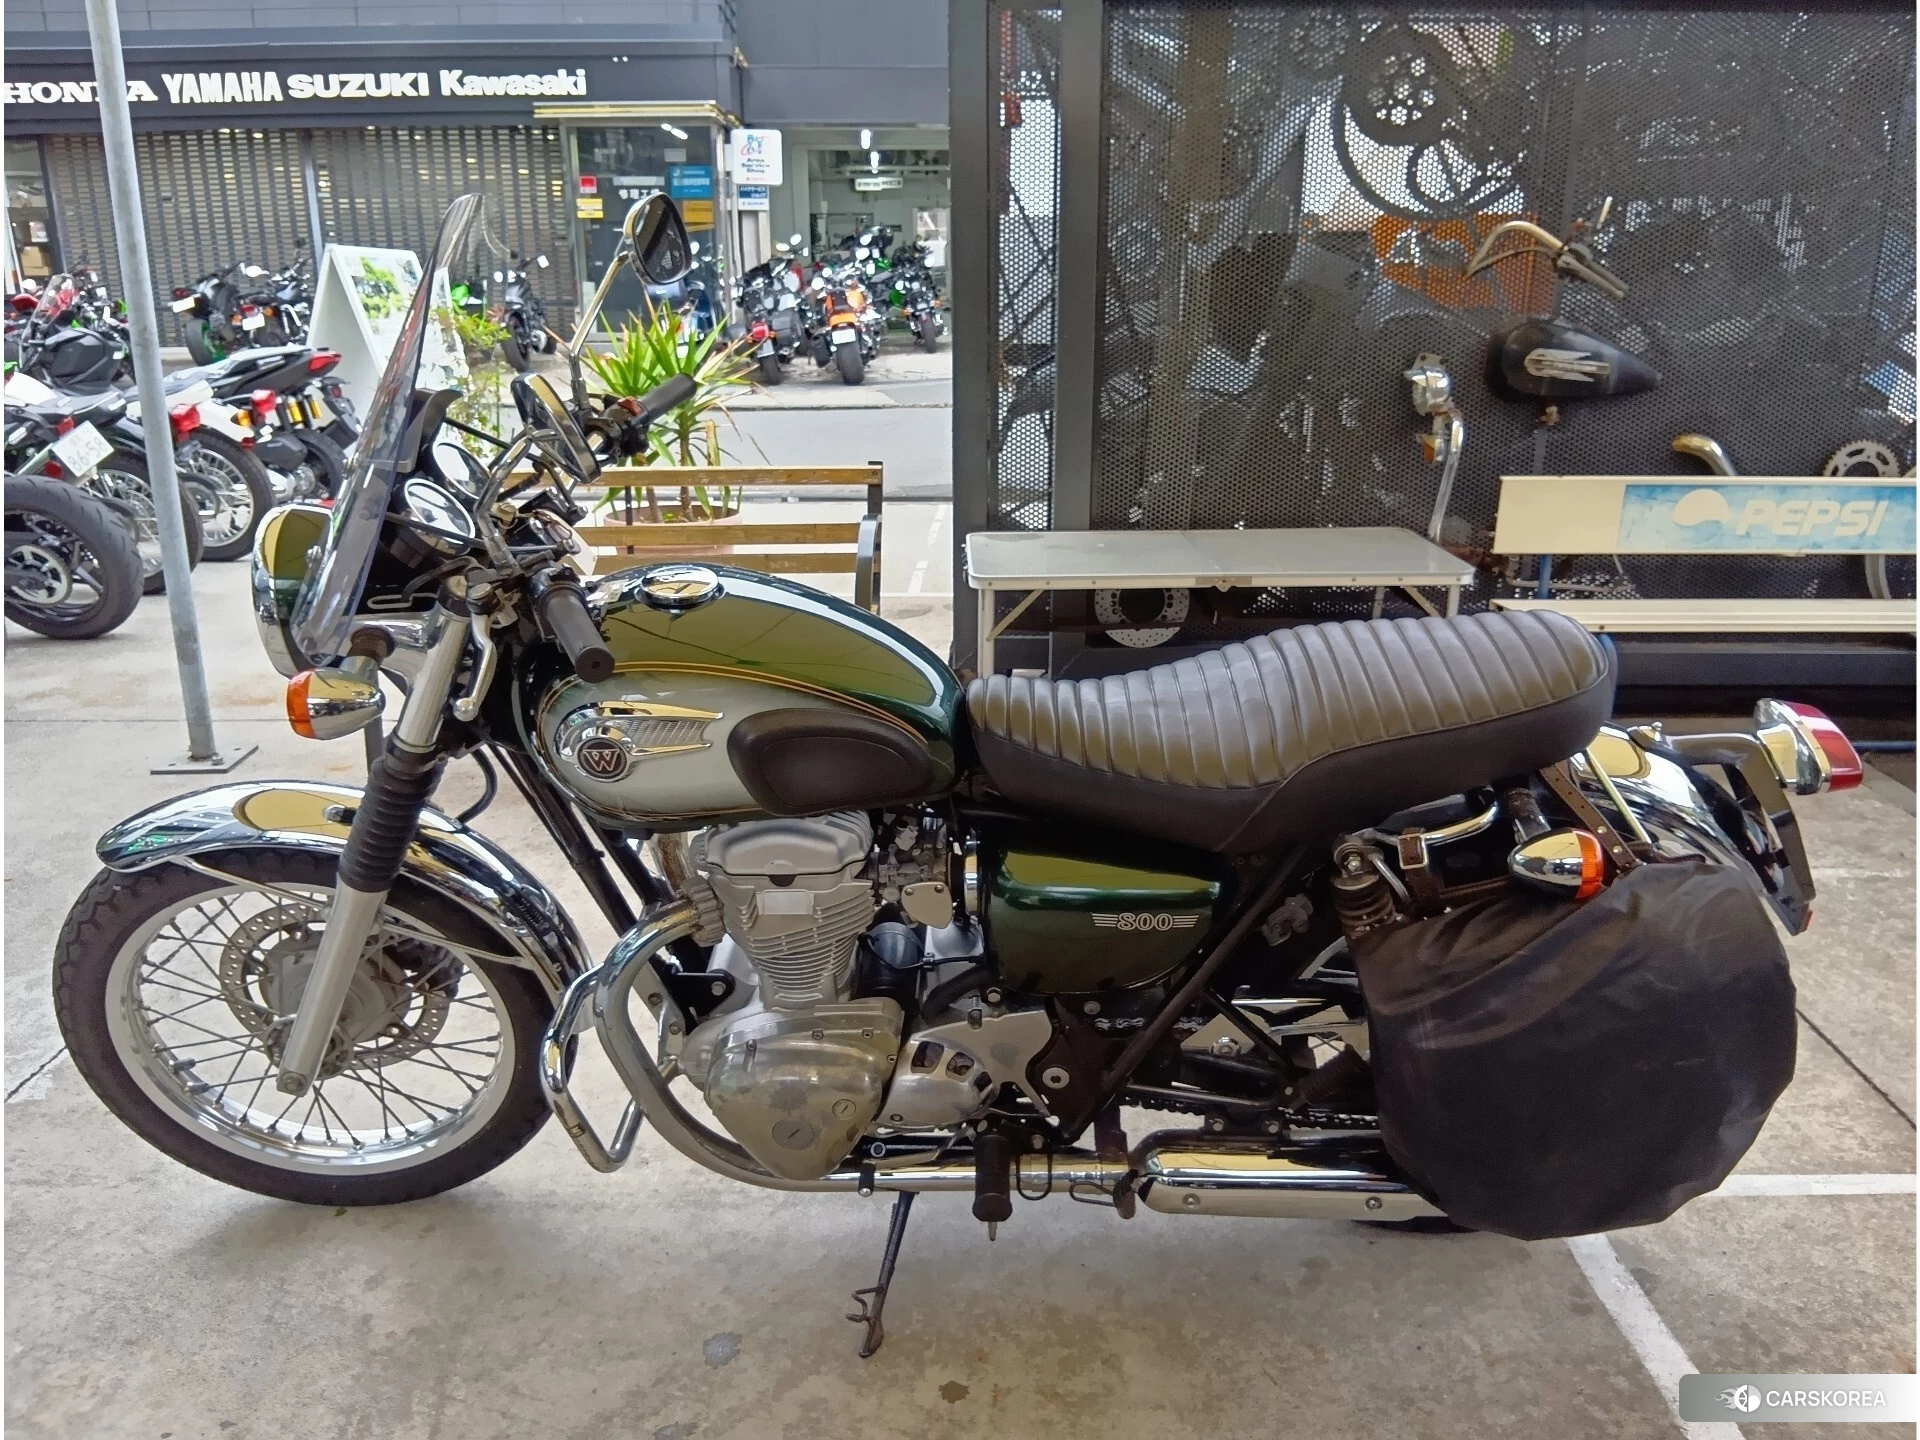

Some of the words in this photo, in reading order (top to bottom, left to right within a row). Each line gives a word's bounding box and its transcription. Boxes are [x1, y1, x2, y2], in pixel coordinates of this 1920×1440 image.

[4, 81, 158, 103] HONA
[161, 72, 283, 104] YAMAHA
[287, 73, 429, 98] SUZUKI
[440, 69, 587, 96] Kawasaki
[1735, 500, 1889, 536] PEPSI
[584, 748, 620, 771] W
[1117, 912, 1174, 931] 800
